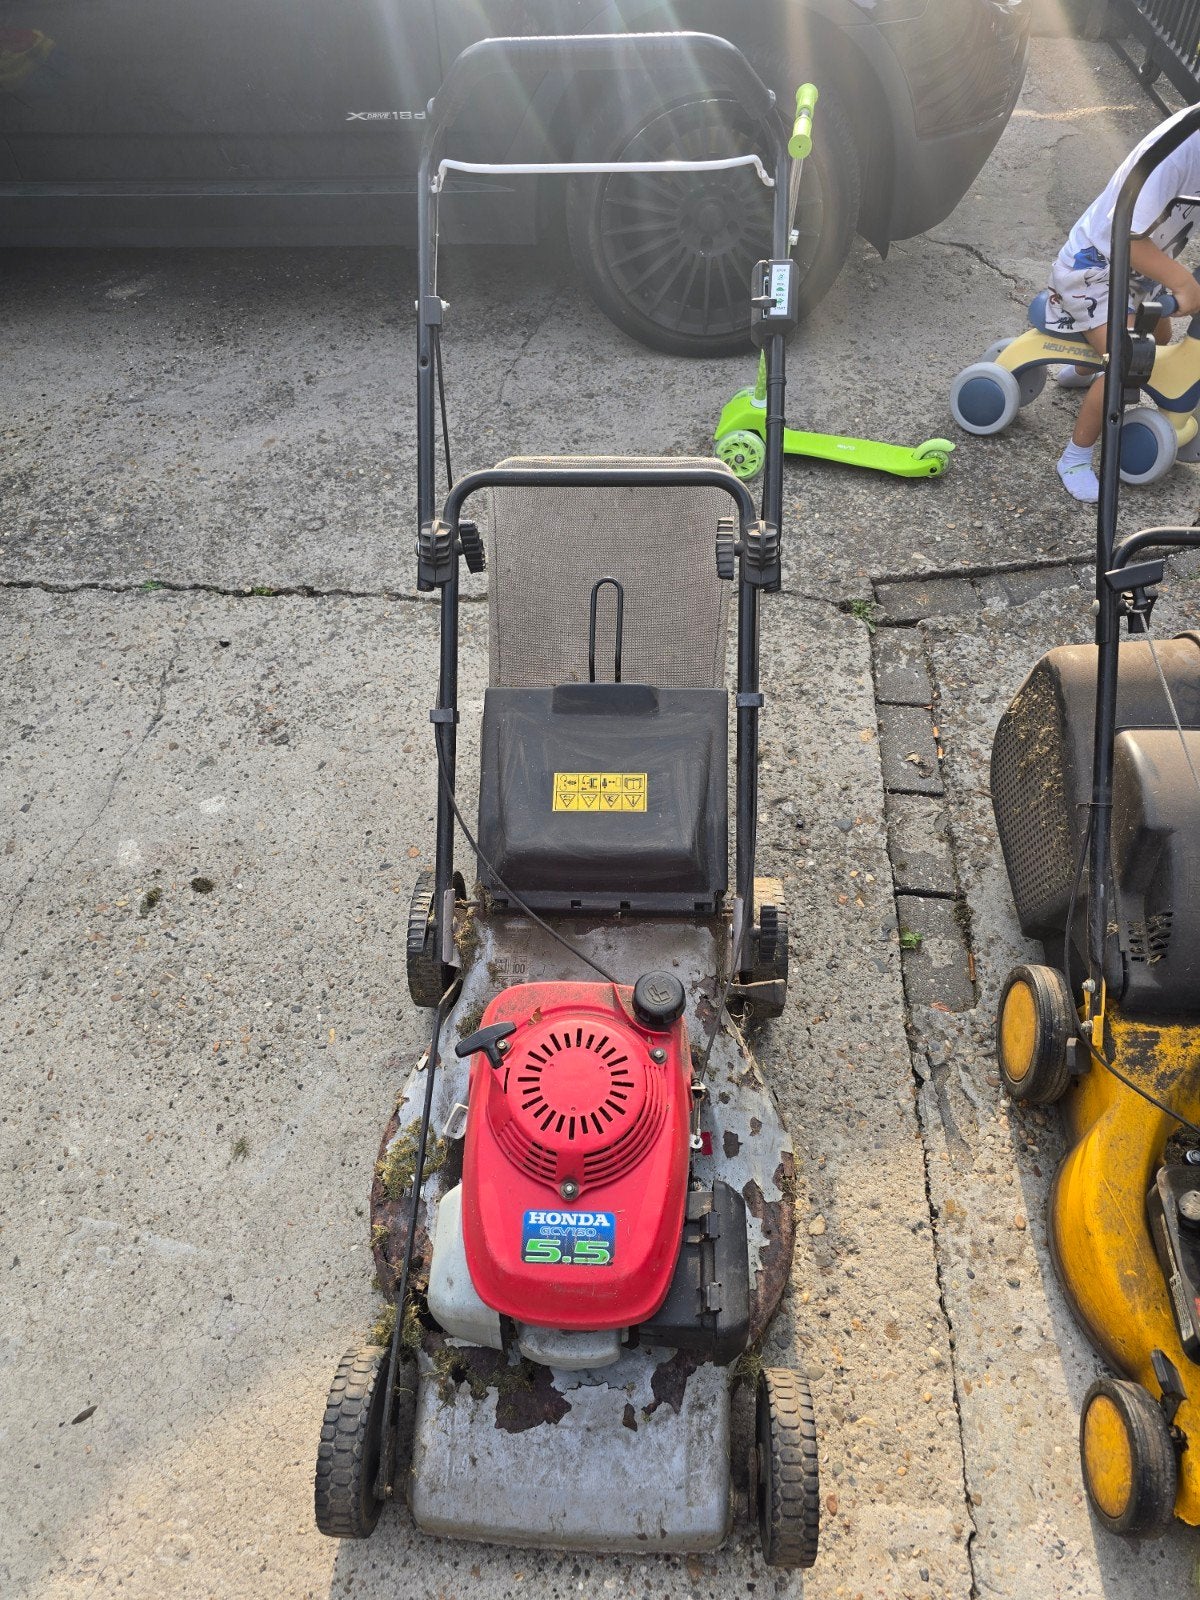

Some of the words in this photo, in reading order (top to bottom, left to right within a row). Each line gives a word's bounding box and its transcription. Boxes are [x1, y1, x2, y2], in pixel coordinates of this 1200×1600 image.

[528, 1211, 610, 1226] HONDA
[540, 1226, 597, 1237] GCV160
[525, 1238, 610, 1265] 5.5
